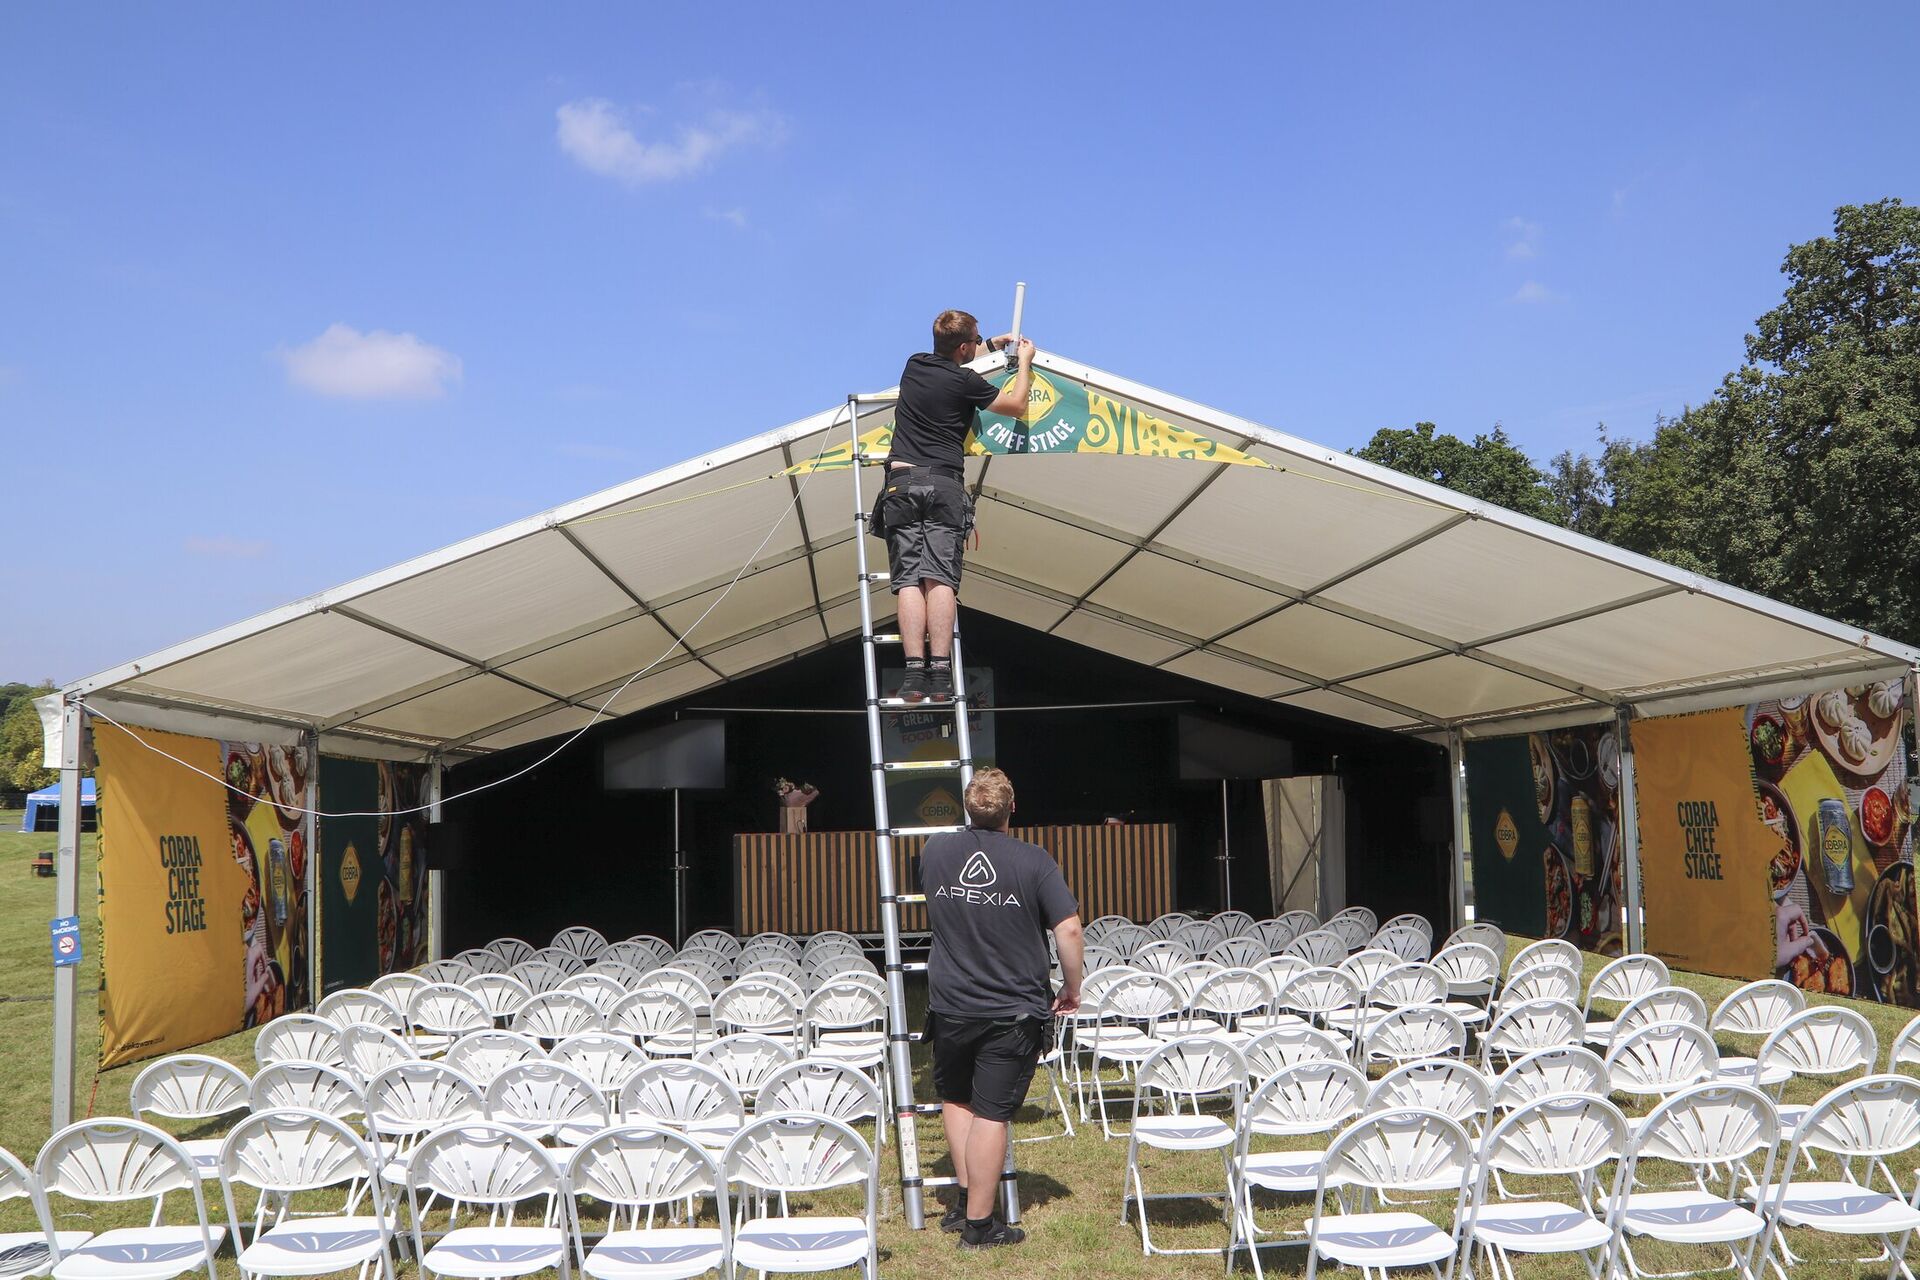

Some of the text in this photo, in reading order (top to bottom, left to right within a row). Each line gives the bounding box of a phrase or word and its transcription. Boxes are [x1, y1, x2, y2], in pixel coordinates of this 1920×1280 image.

[986, 417, 1076, 453] CHEF STAGE
[922, 806, 957, 817] COBRA
[1677, 800, 1720, 827] COBRA
[1498, 829, 1517, 841] COBRA
[1685, 827, 1716, 853] CHEF
[1825, 840, 1848, 850] COBRA
[159, 835, 203, 868] COBRA
[342, 866, 359, 881] COBRA
[1684, 852, 1724, 880] STAGE
[168, 867, 200, 900] CHEF
[935, 885, 1021, 908] APEXIA
[165, 898, 207, 934] STAGE
[52, 924, 79, 935] SMOKING
